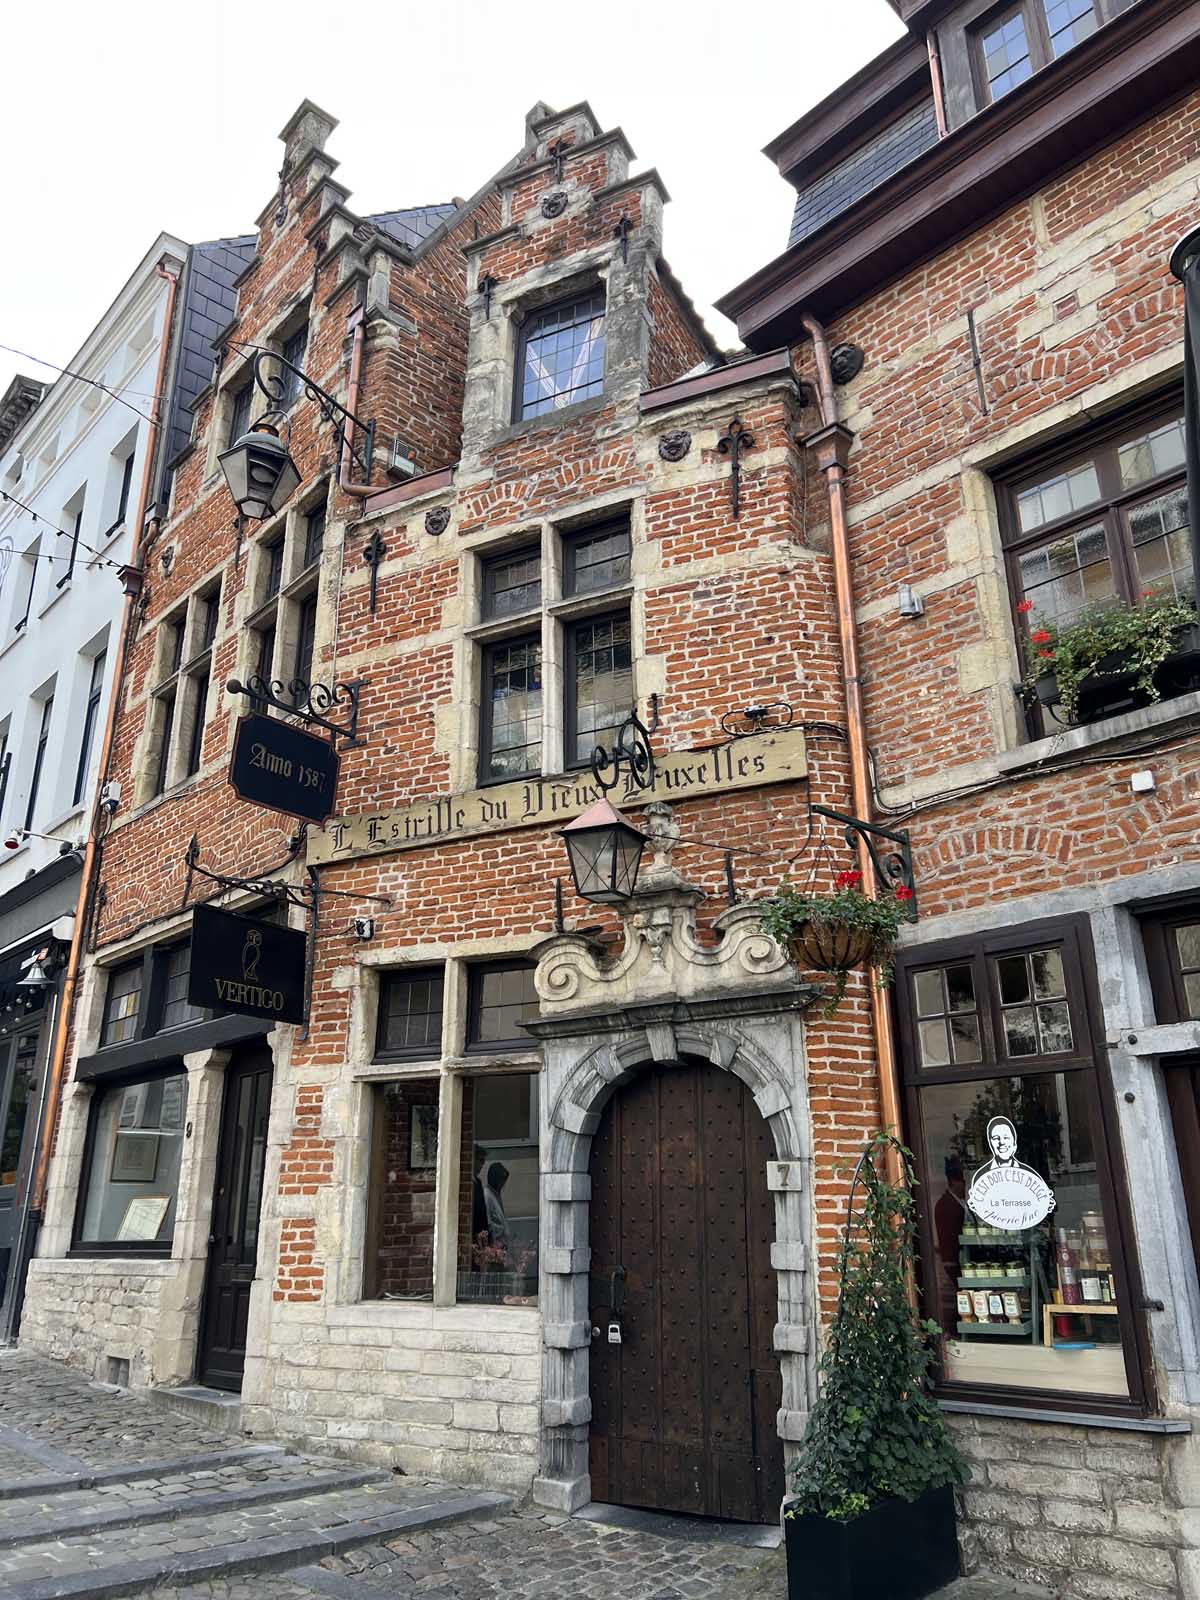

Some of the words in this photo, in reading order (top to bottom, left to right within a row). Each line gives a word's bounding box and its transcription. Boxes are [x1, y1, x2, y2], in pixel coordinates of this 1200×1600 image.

[249, 742, 292, 777] Anno
[298, 765, 326, 793] 1587
[330, 795, 465, 858] L'Estrille
[479, 797, 508, 823] du
[520, 776, 603, 823] Vieux
[214, 978, 284, 1011] VERTIGO
[186, 1121, 193, 1138] 9
[777, 1164, 790, 1187] 7
[990, 1199, 1000, 1207] La
[1001, 1199, 1032, 1207] Terrasse
